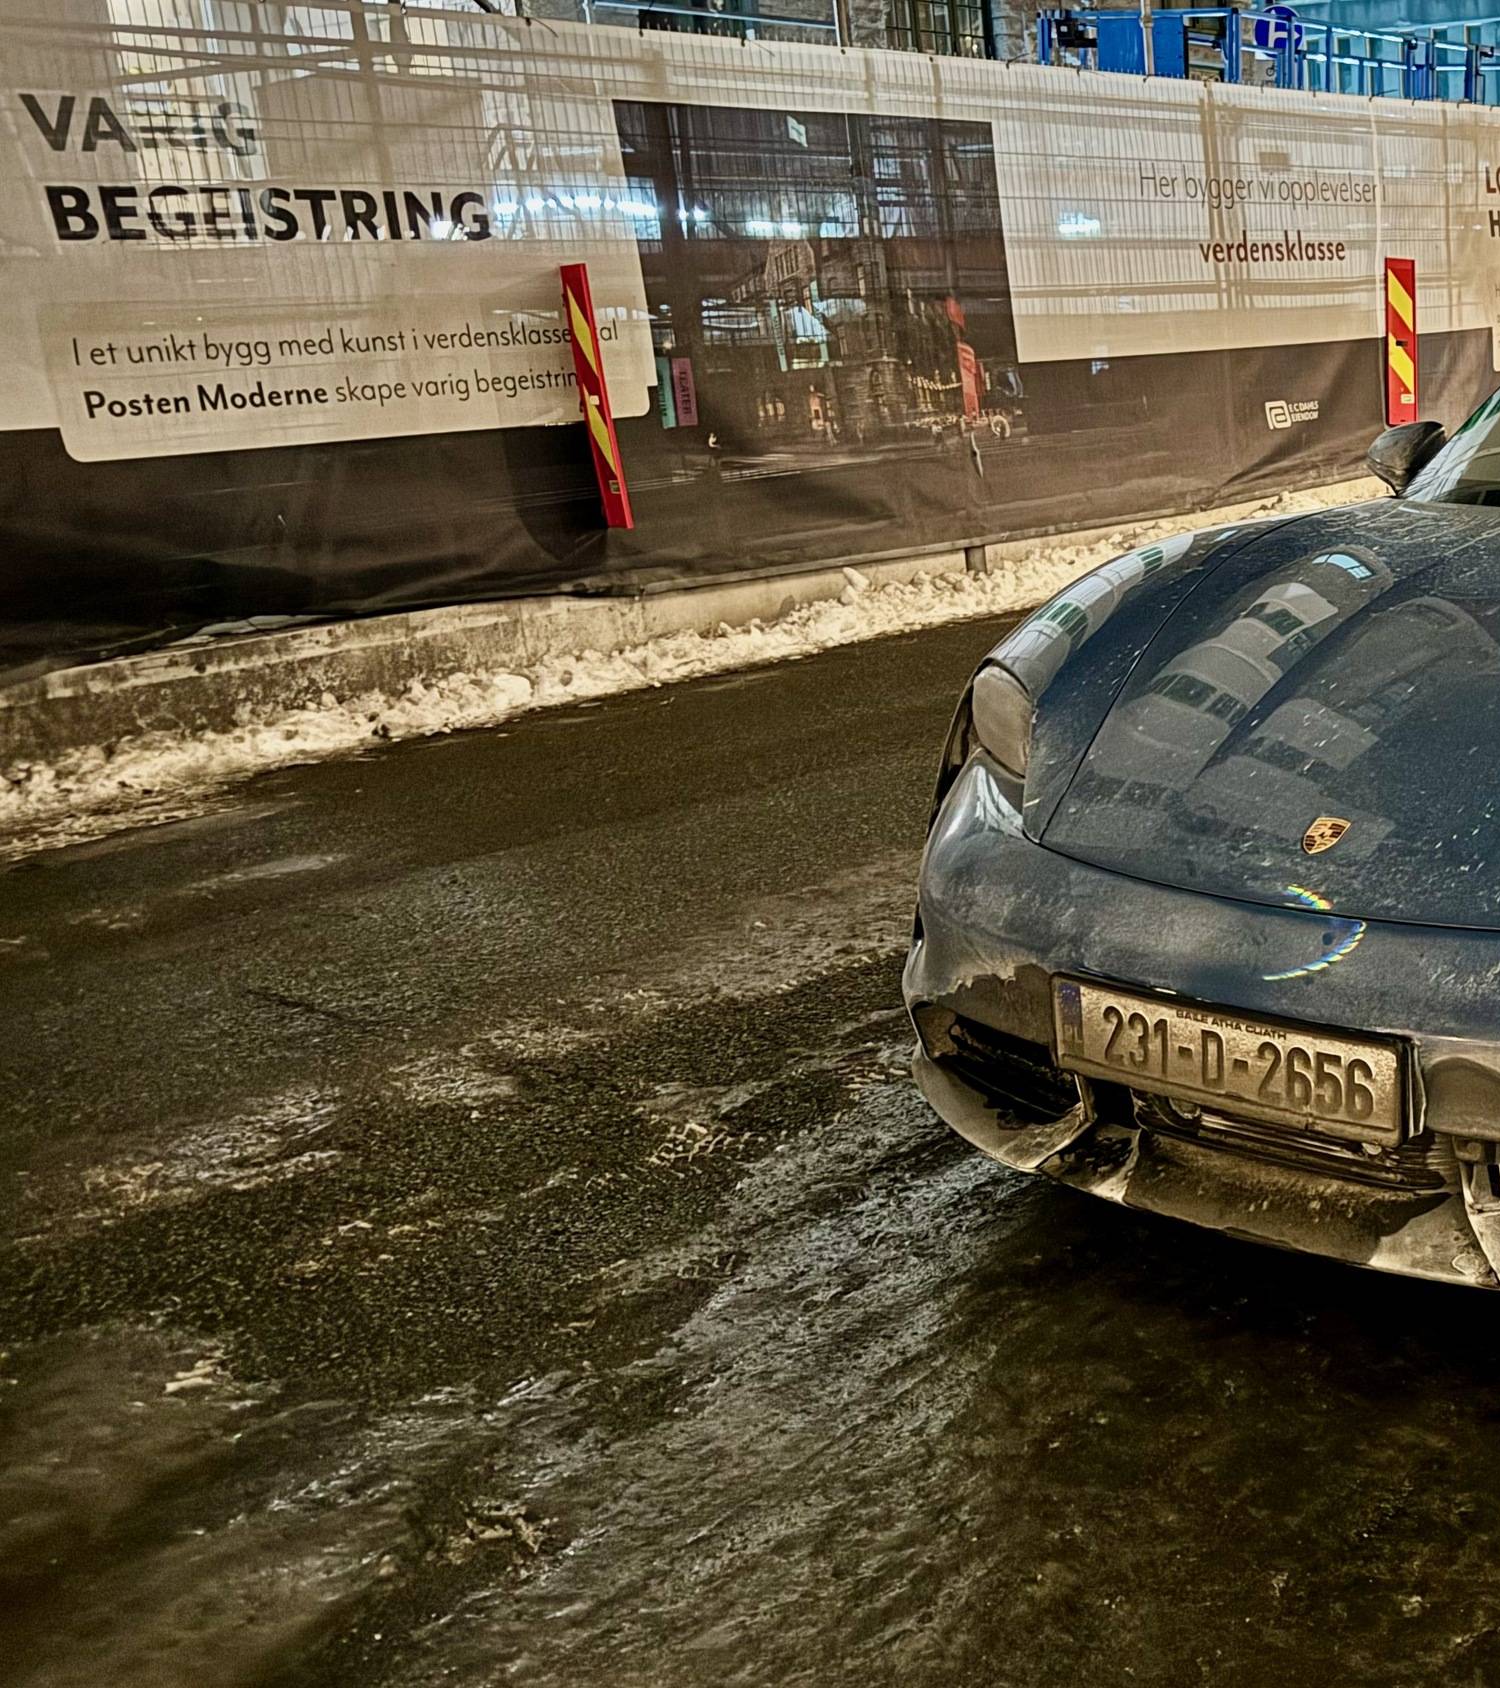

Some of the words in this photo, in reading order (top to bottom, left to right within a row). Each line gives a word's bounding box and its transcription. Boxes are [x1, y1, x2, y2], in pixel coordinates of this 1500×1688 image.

[1138, 161, 1178, 198] Her
[1182, 164, 1254, 210] bygger
[1259, 170, 1274, 200] vi
[1278, 170, 1377, 210] opplevelser
[44, 184, 492, 242] BEGEISTRING
[1199, 229, 1346, 264] verdensklasse
[73, 337, 81, 366] I
[89, 342, 117, 366] et
[127, 333, 197, 364] unikt
[202, 332, 272, 367] bygg
[278, 327, 335, 357] med
[340, 327, 405, 354] kunst
[411, 328, 419, 351] i
[423, 321, 572, 349] verdensklasse
[83, 390, 192, 419] Posten
[196, 380, 330, 412] Moderne
[335, 375, 407, 406] skape
[411, 373, 470, 405] varig
[473, 368, 578, 398] begeistrin
[1102, 1004, 1375, 1121] 231-D-2656
